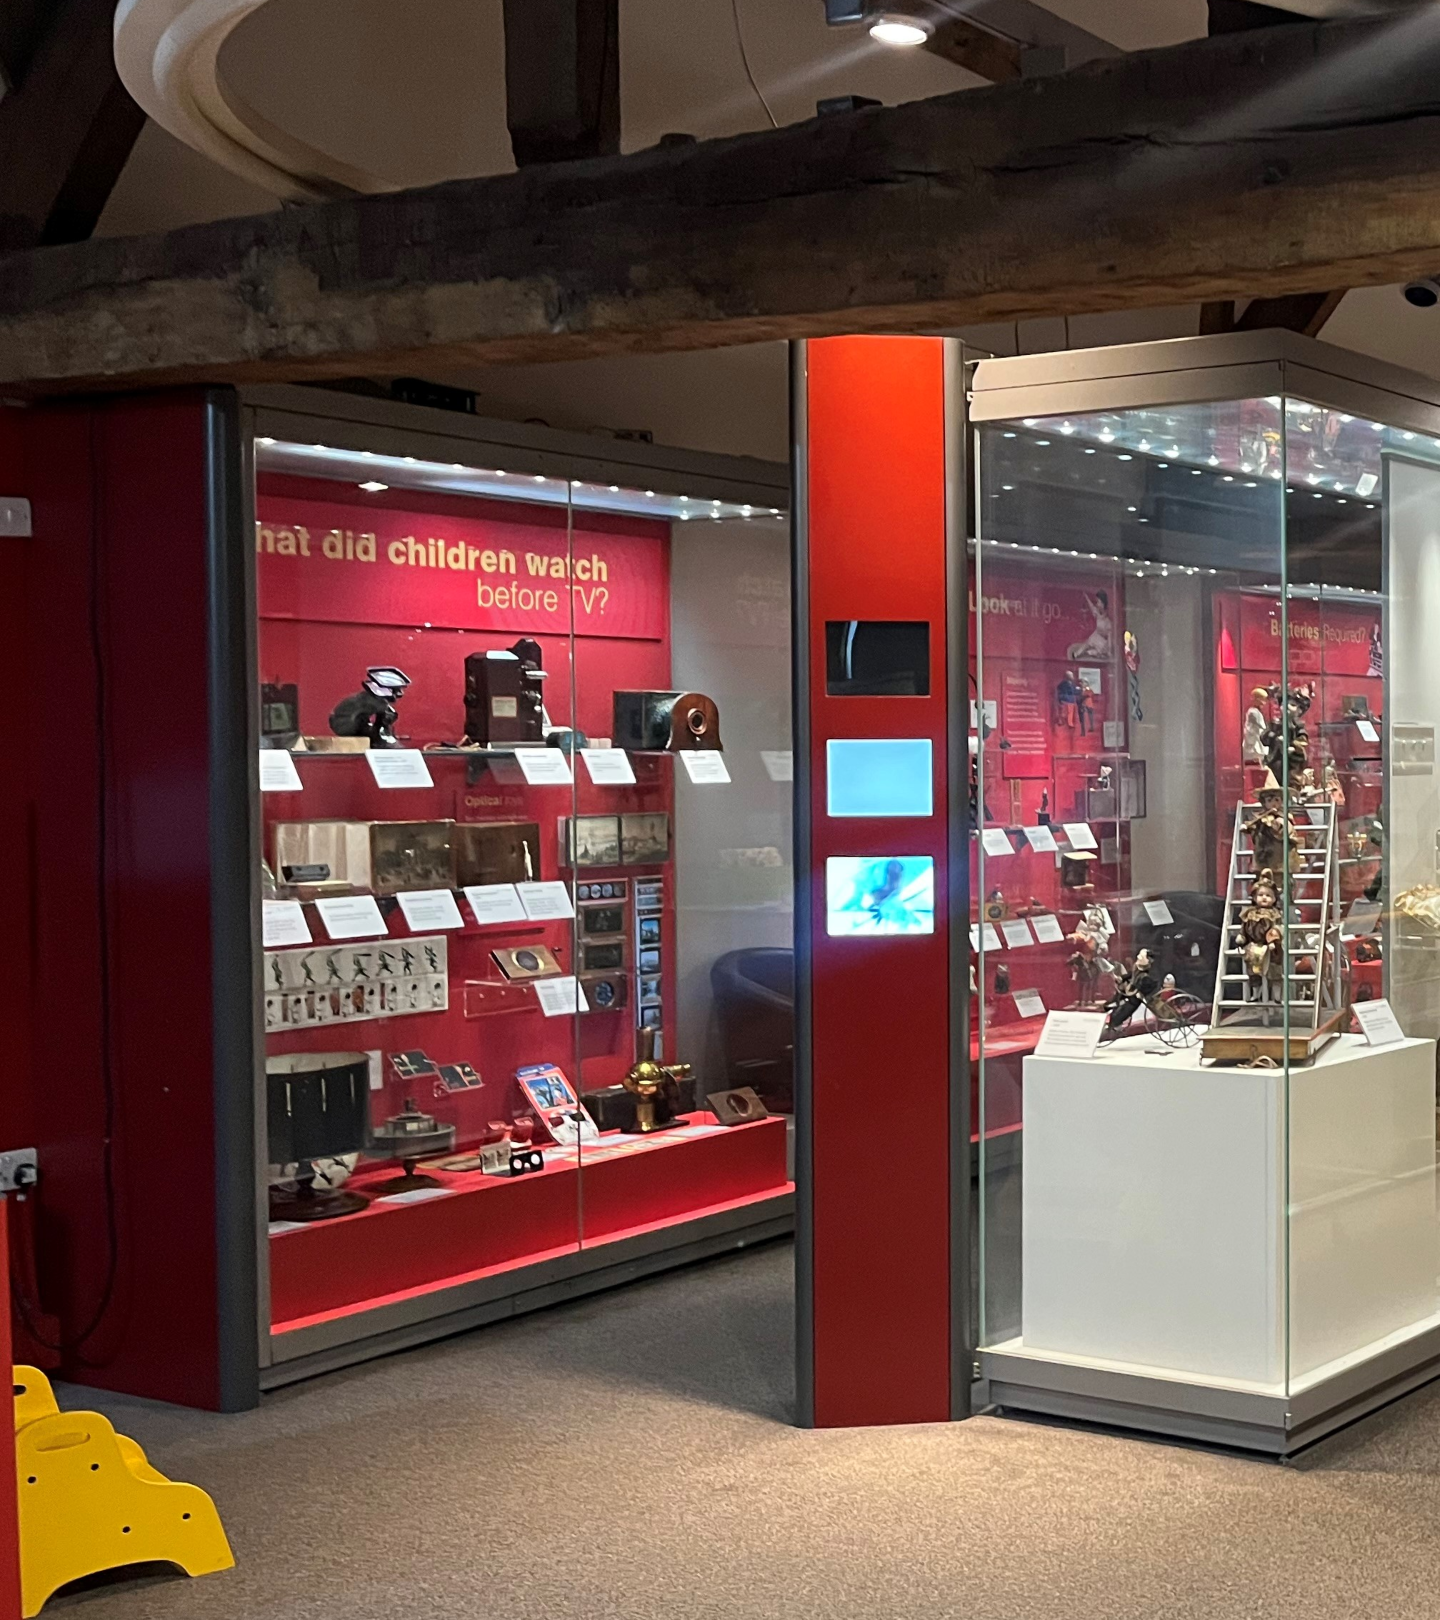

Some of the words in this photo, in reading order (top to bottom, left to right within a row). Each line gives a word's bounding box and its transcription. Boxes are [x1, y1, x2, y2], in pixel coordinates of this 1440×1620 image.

[255, 521, 311, 557] hat
[322, 528, 377, 563] did
[388, 536, 517, 575] children
[525, 552, 608, 582] watch
[477, 579, 558, 612] before
[968, 590, 1011, 615] Look
[1270, 619, 1320, 641] Bteries
[1322, 623, 1367, 646] Required?
